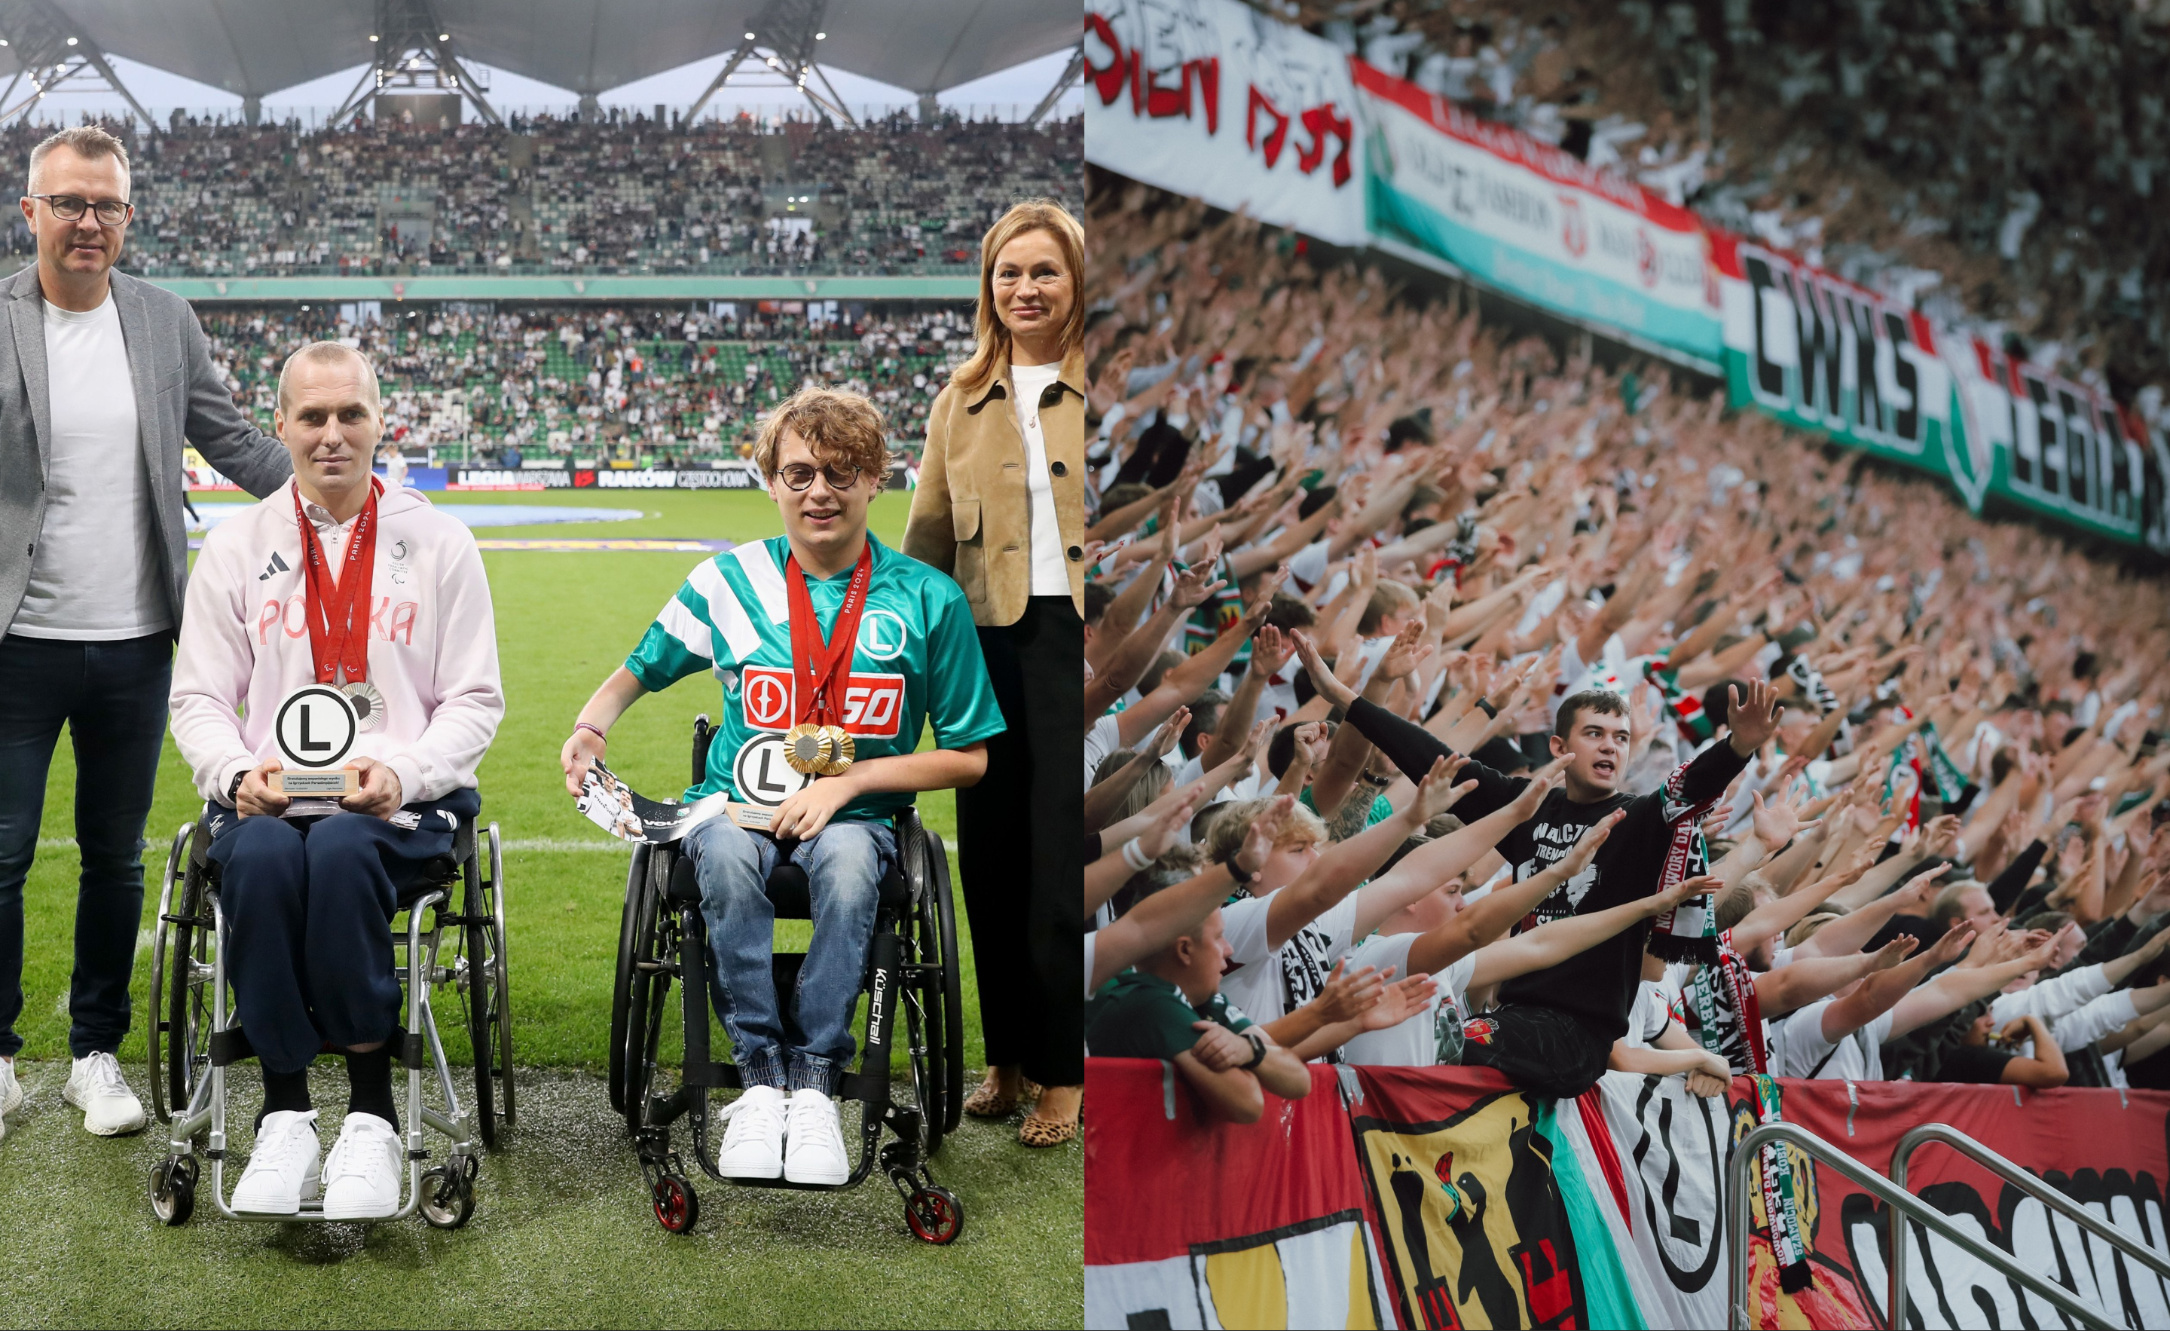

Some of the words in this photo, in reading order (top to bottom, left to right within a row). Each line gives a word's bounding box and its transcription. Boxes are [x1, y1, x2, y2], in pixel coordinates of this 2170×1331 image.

[1742, 250, 1923, 452] CWKS
[458, 470, 514, 486] LEGIA
[513, 471, 570, 487] WARSZAWA
[598, 467, 677, 488] RAKÓW
[350, 535, 362, 561] PARIS
[358, 510, 371, 533] 2024
[844, 590, 857, 614] PARIS
[853, 568, 865, 589] 2024
[258, 594, 419, 646] POKA
[869, 617, 893, 651] L
[300, 704, 331, 751] L
[757, 748, 786, 793] L
[643, 819, 688, 828] VOU
[1655, 844, 1685, 930] NOWORY
[1695, 968, 1716, 1032] DERBY
[1783, 1198, 1804, 1257] SZAMOCIN
